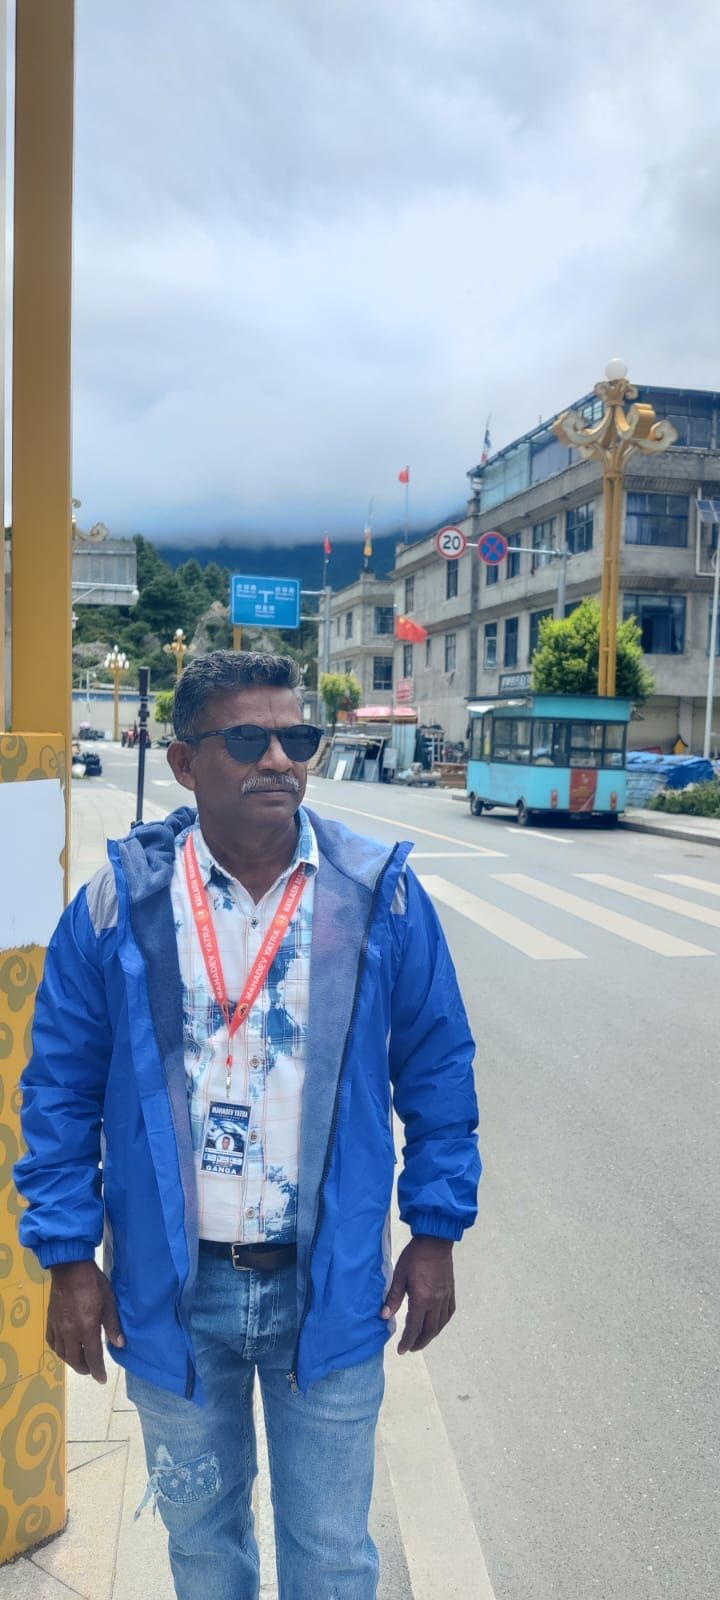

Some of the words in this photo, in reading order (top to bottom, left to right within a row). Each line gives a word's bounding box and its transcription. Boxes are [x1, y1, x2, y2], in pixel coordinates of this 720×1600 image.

[442, 535, 461, 550] 20
[202, 924, 213, 953] YATRA
[208, 955, 223, 999] MAHADEV
[245, 957, 268, 1001] MAHADEV
[264, 930, 281, 956] YATRA
[206, 1165, 236, 1174] GANGA
